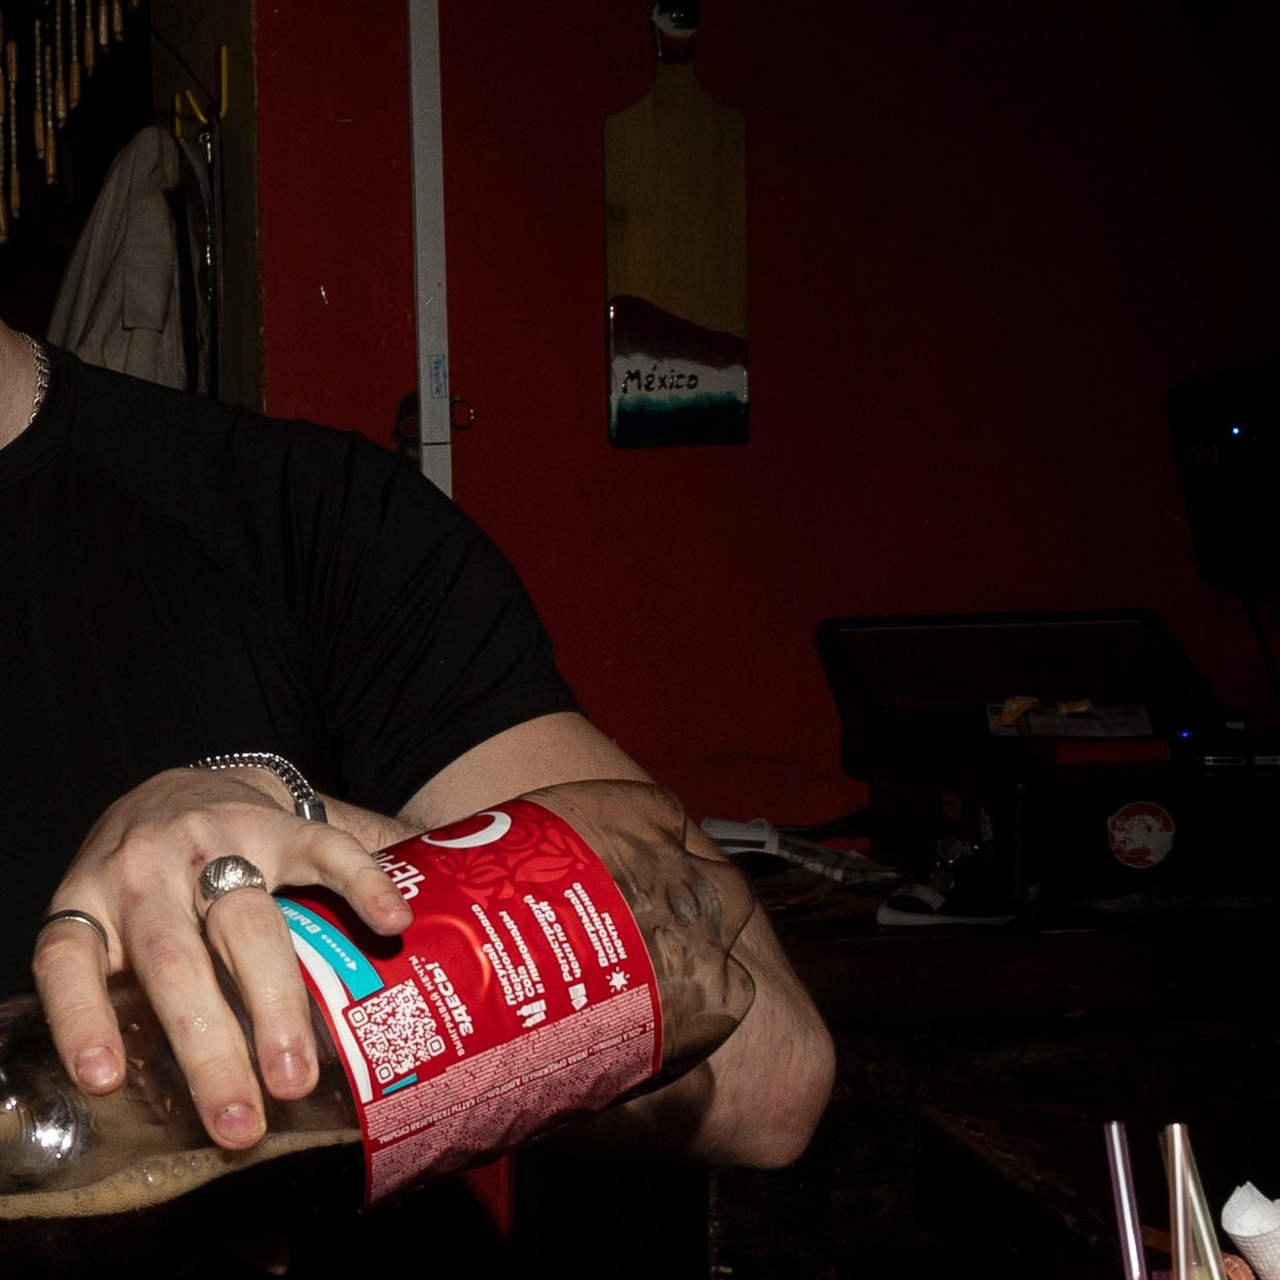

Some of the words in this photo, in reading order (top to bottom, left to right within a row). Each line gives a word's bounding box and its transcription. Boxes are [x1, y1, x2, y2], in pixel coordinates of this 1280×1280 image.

[622, 364, 699, 394] México
[523, 894, 573, 982] Регистрируй
[539, 901, 557, 923] QR
[552, 923, 567, 942] по
[563, 889, 609, 967] Выигрывай
[572, 882, 618, 963] исполнение
[601, 912, 628, 960] мечты
[408, 955, 436, 992] МЕЧТЫ
[471, 903, 526, 1002] Черноголовка
[498, 910, 541, 982] лимонады
[561, 942, 582, 978] чеки
[482, 943, 517, 1006] Покупай
[517, 965, 535, 998] Cola
[430, 991, 466, 1056] ВЫИГРЫВАЙ
